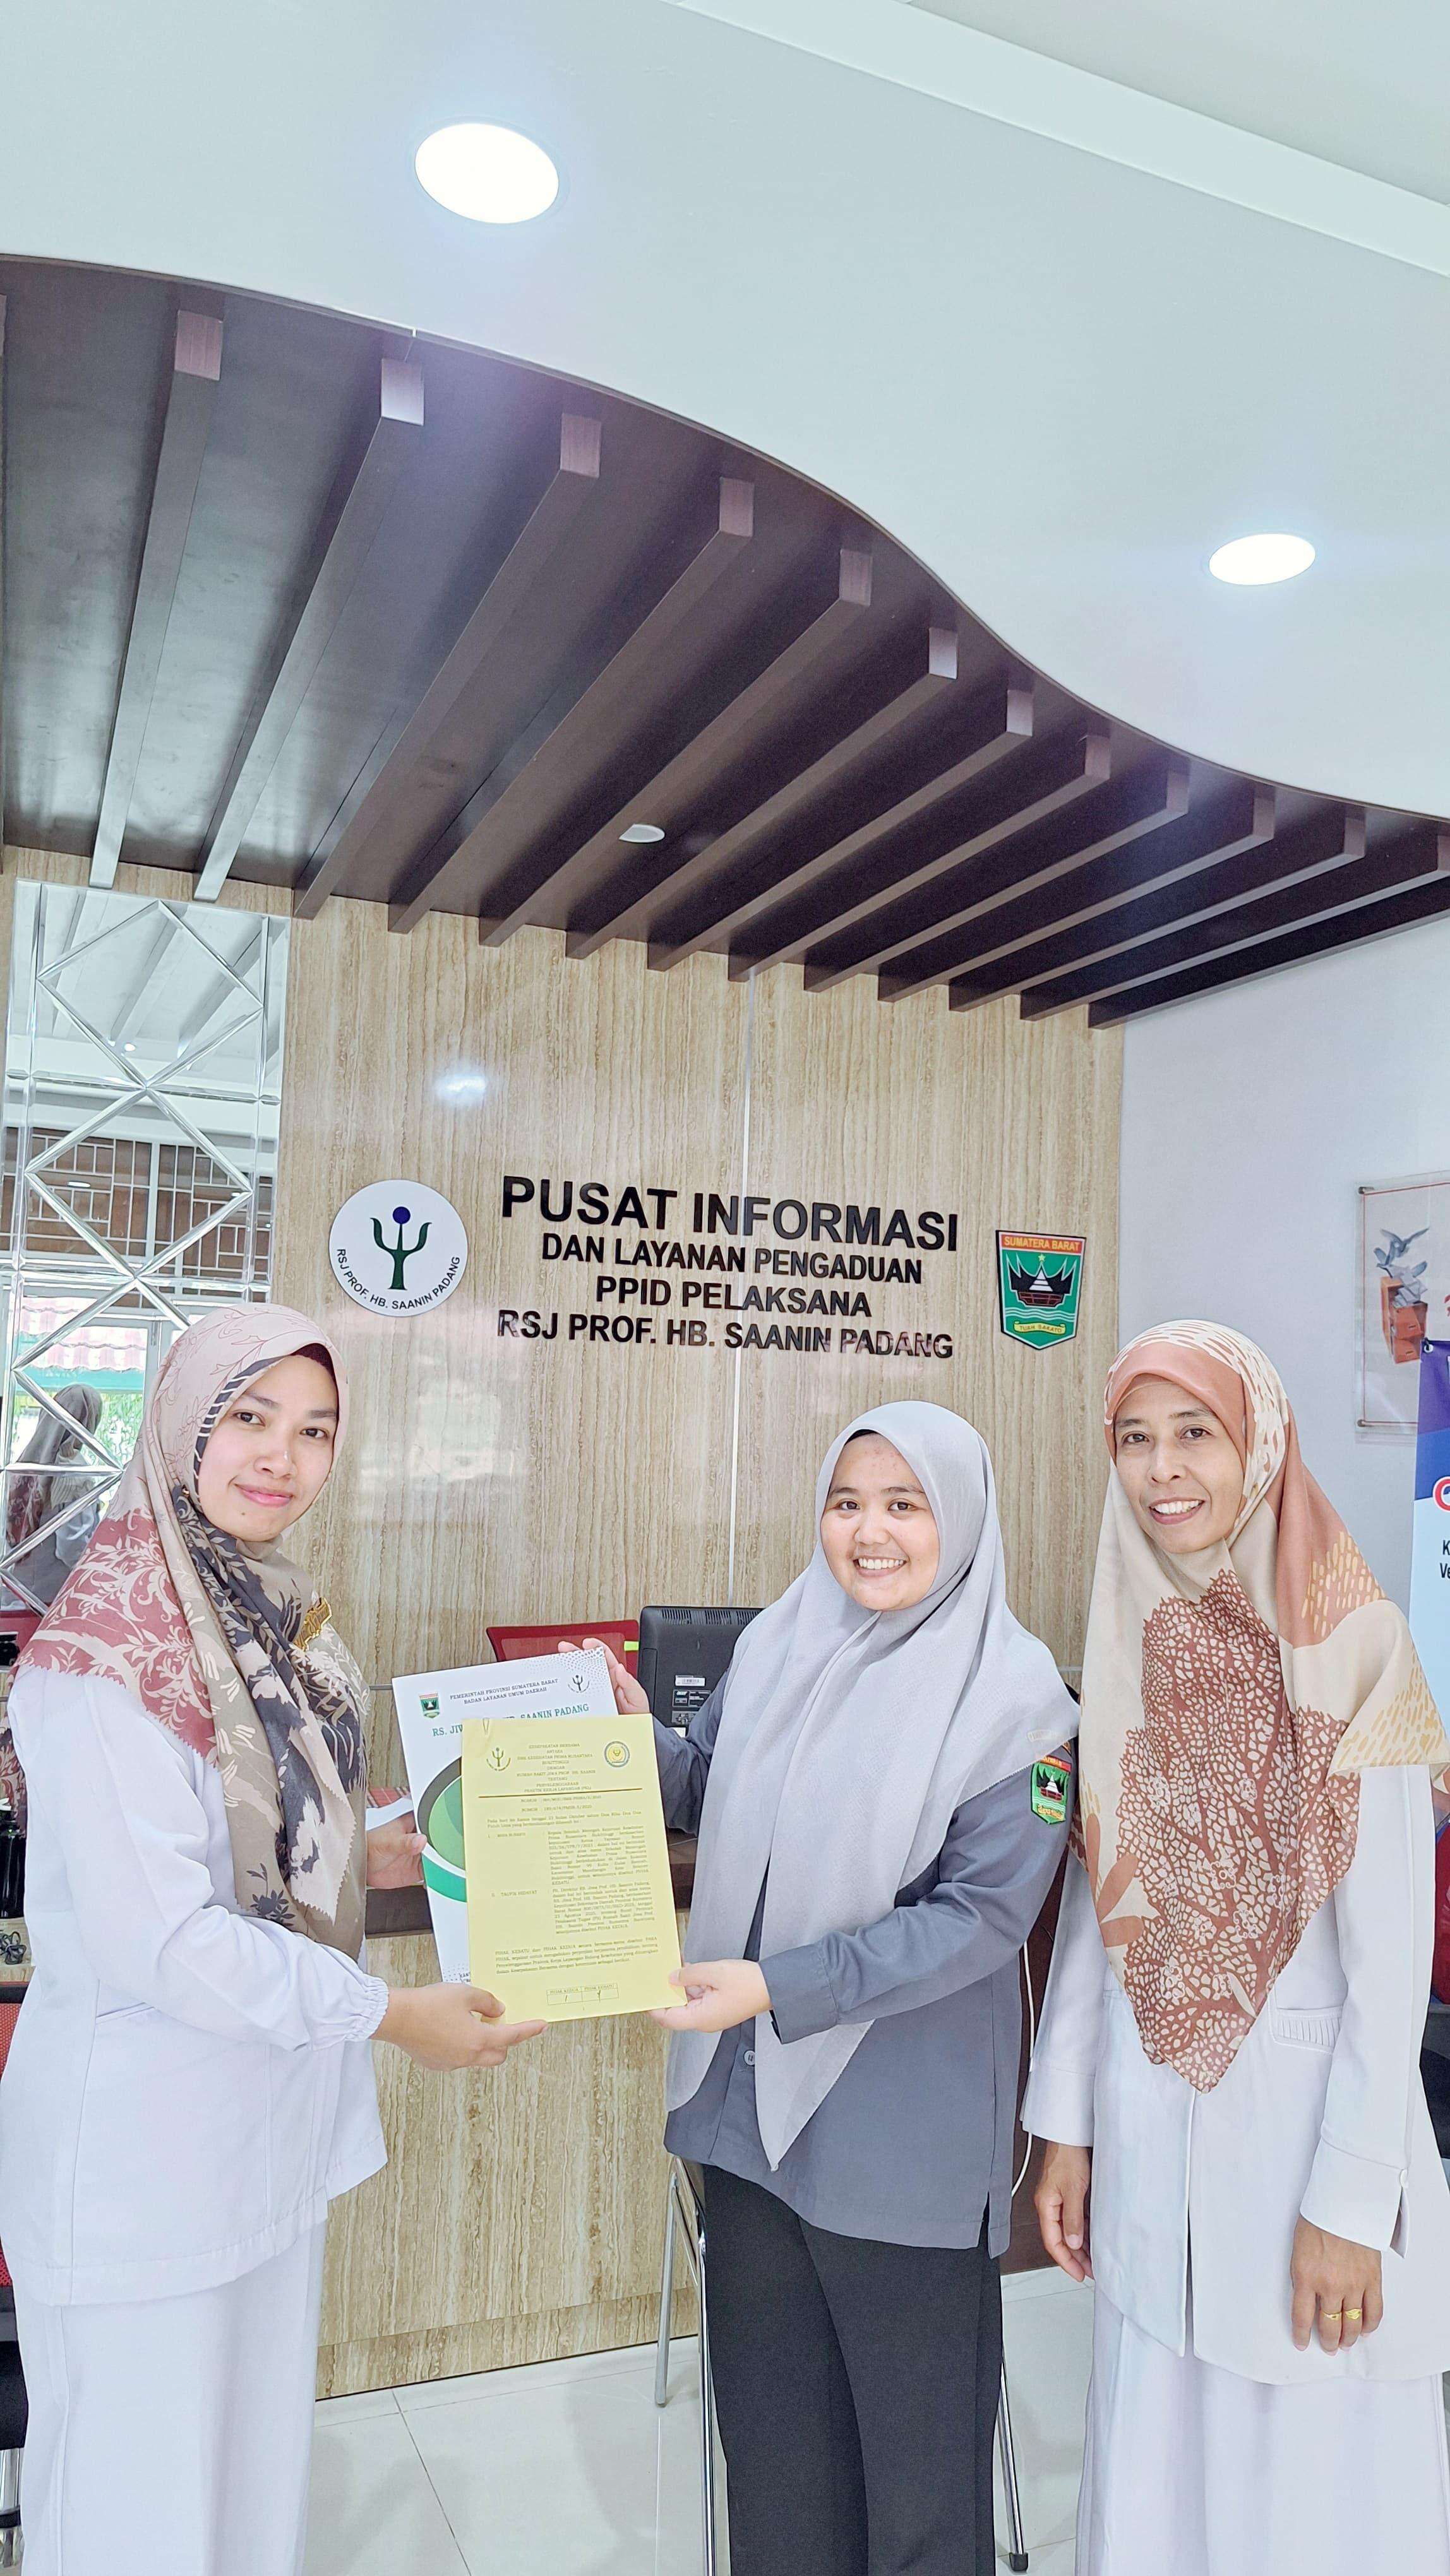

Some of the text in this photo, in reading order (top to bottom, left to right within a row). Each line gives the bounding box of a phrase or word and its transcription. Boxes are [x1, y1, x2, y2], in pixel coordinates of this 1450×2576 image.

[502, 1175, 959, 1252] PUSAT INFORMASI
[542, 1233, 922, 1284] DAN LAYANAN PENGADUAN
[1004, 1237, 1080, 1251] SUMATERA BARAT
[337, 1248, 460, 1309] RSJ PROF. HB. SAANIN PADANG
[596, 1275, 872, 1318] PPID PELAKSANA
[498, 1309, 954, 1359] RSJ PROF. HB. SAANIN PADANG
[450, 1691, 484, 1700] PEMERINTAH
[512, 1682, 539, 1691] SUMATERA
[554, 1704, 589, 1717] PADANG
[433, 1727, 447, 1736] RS.
